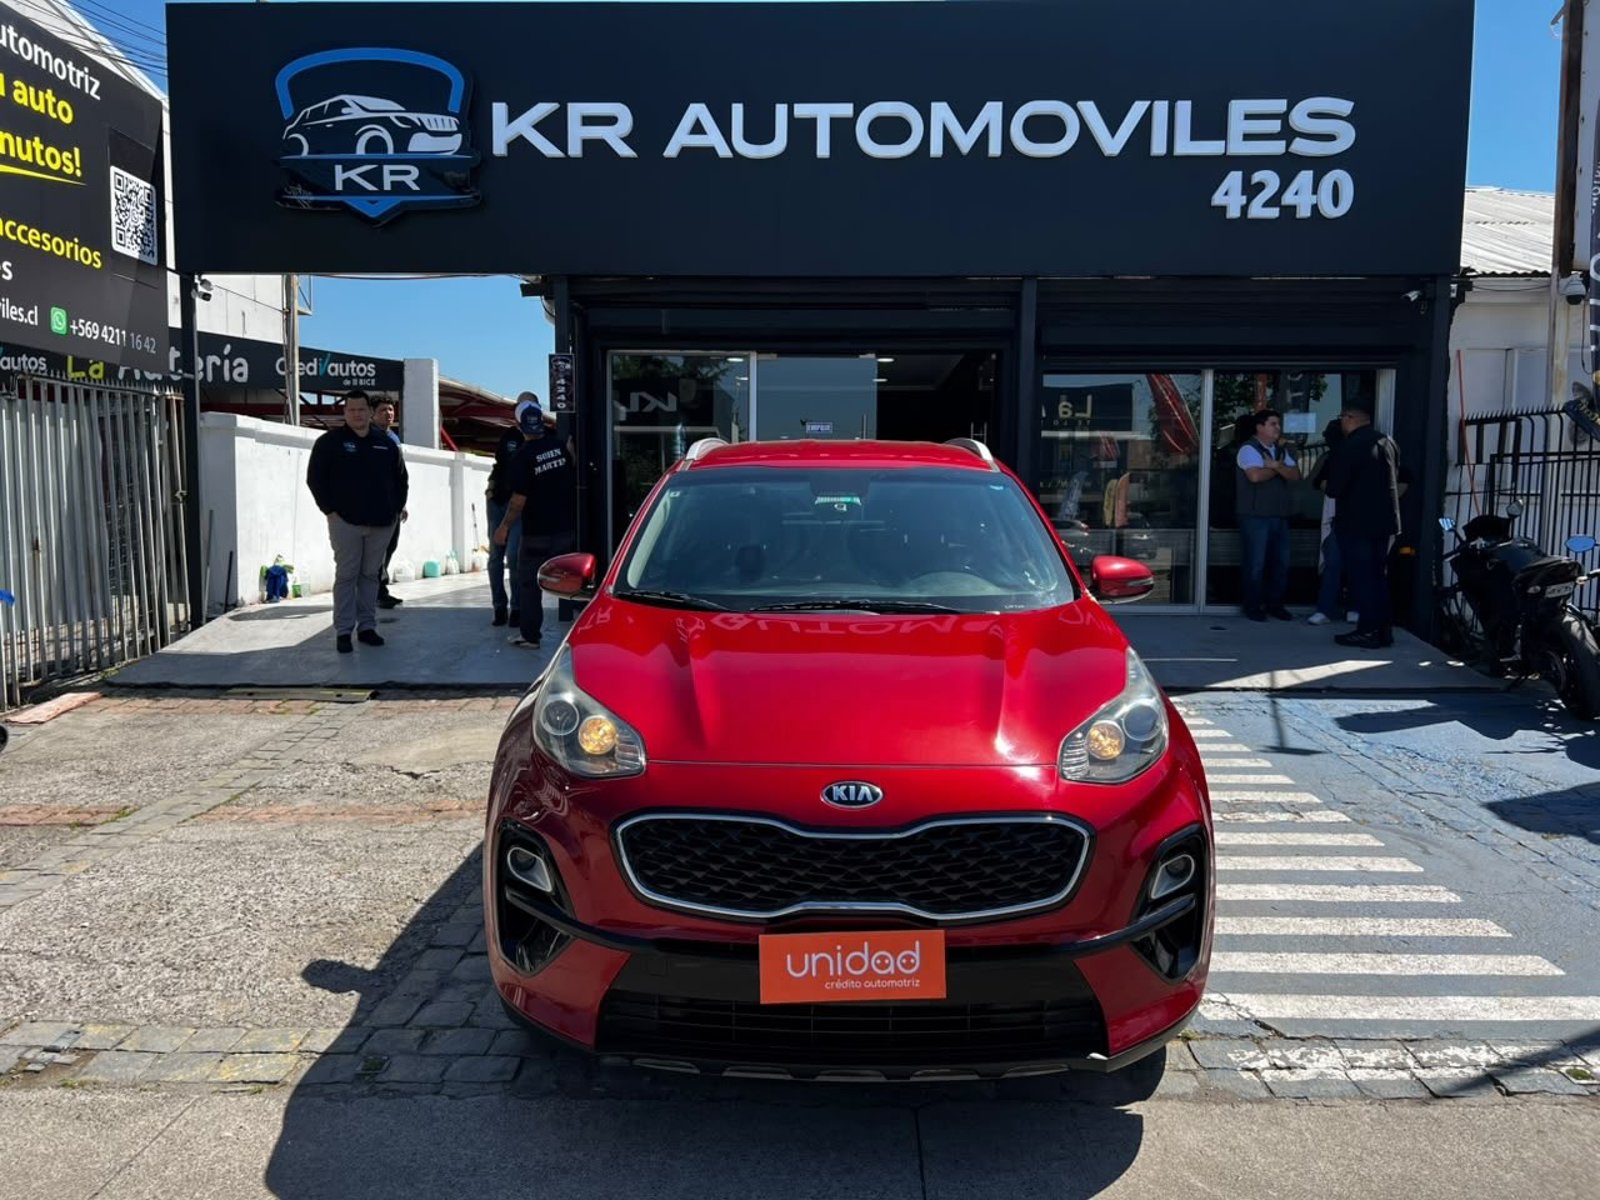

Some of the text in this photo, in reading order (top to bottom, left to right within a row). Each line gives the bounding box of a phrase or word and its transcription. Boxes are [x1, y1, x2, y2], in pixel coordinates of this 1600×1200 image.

[13, 80, 74, 124] auto
[491, 96, 1357, 159] KR AUTOMOVILES
[334, 164, 421, 191] KR
[1210, 168, 1355, 220] 4240
[0, 217, 102, 269] ccesorios
[0, 297, 39, 326] iles.cl
[70, 318, 156, 354] +569 4211 16 42
[67, 355, 104, 379] La
[832, 785, 874, 801] KIA
[786, 940, 920, 977] unidad
[825, 977, 920, 990] crédito automotriz
